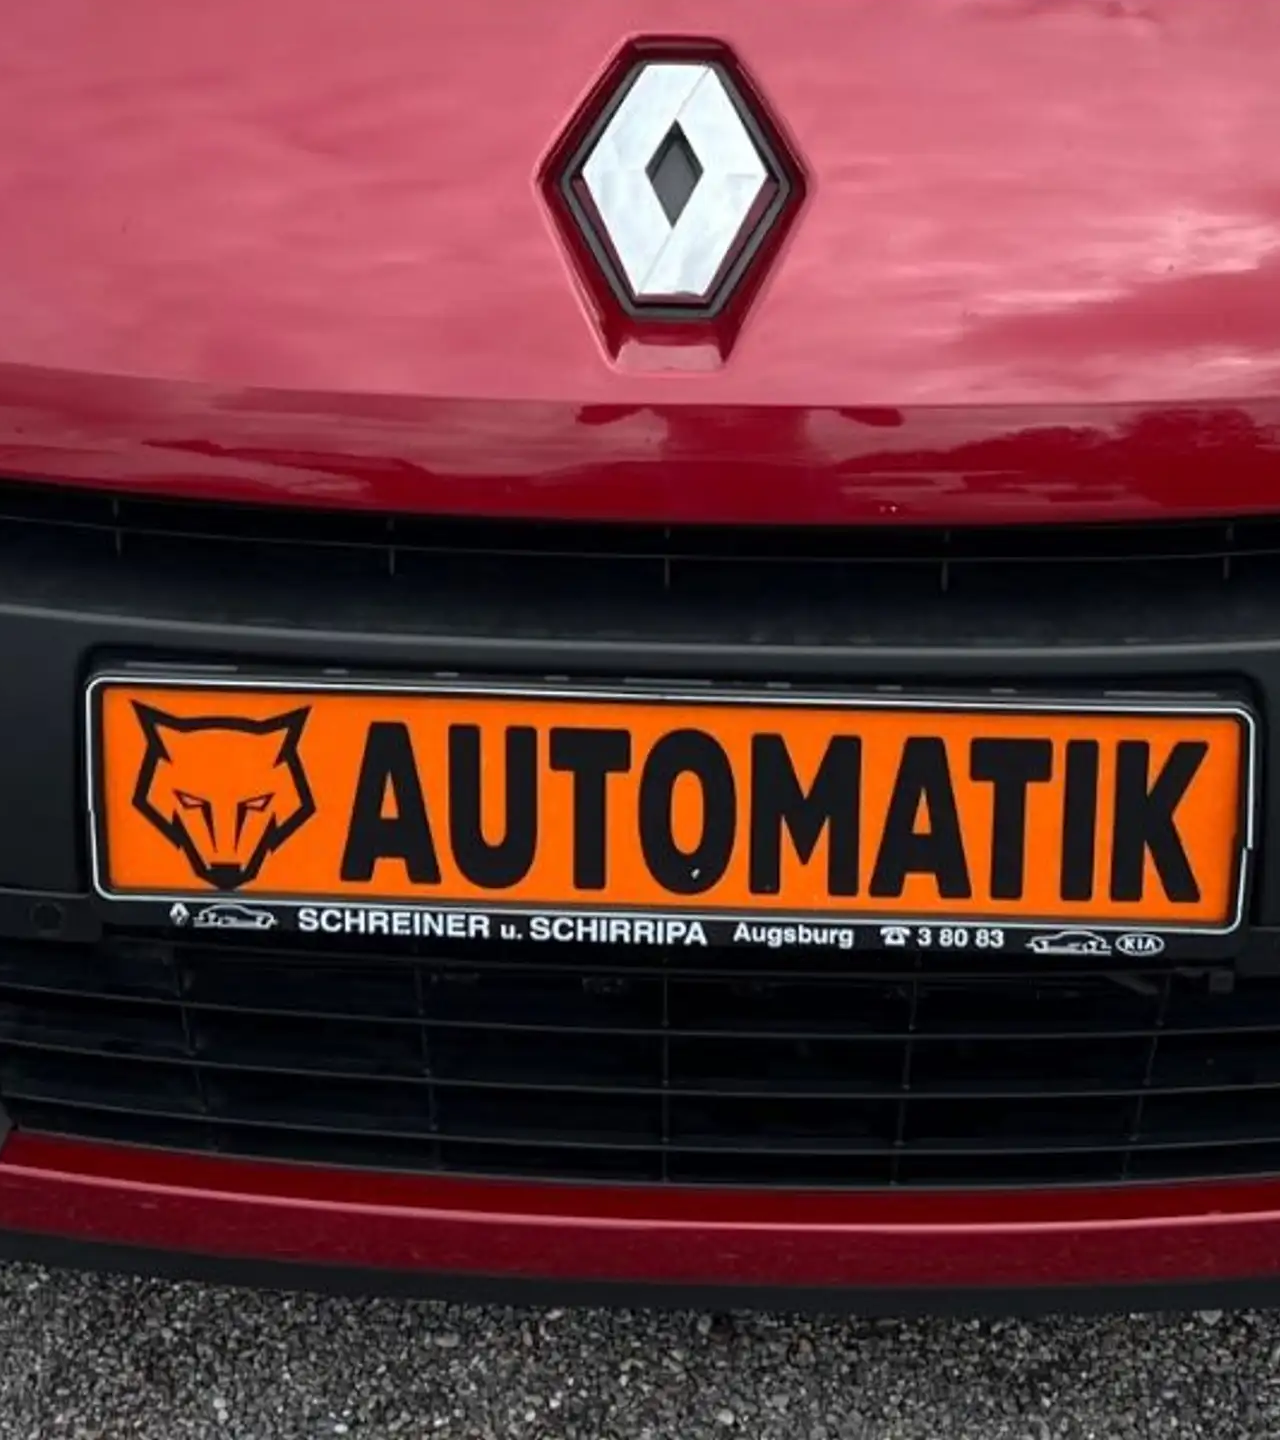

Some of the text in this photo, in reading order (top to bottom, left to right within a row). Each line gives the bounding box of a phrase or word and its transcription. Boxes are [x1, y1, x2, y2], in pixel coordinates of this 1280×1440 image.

[339, 721, 1209, 904] AUTOMATIK
[297, 907, 1005, 949] SCHREINER u. SCHIRRIPA Augsburg 3 80 83
[1124, 934, 1158, 953] KIA
